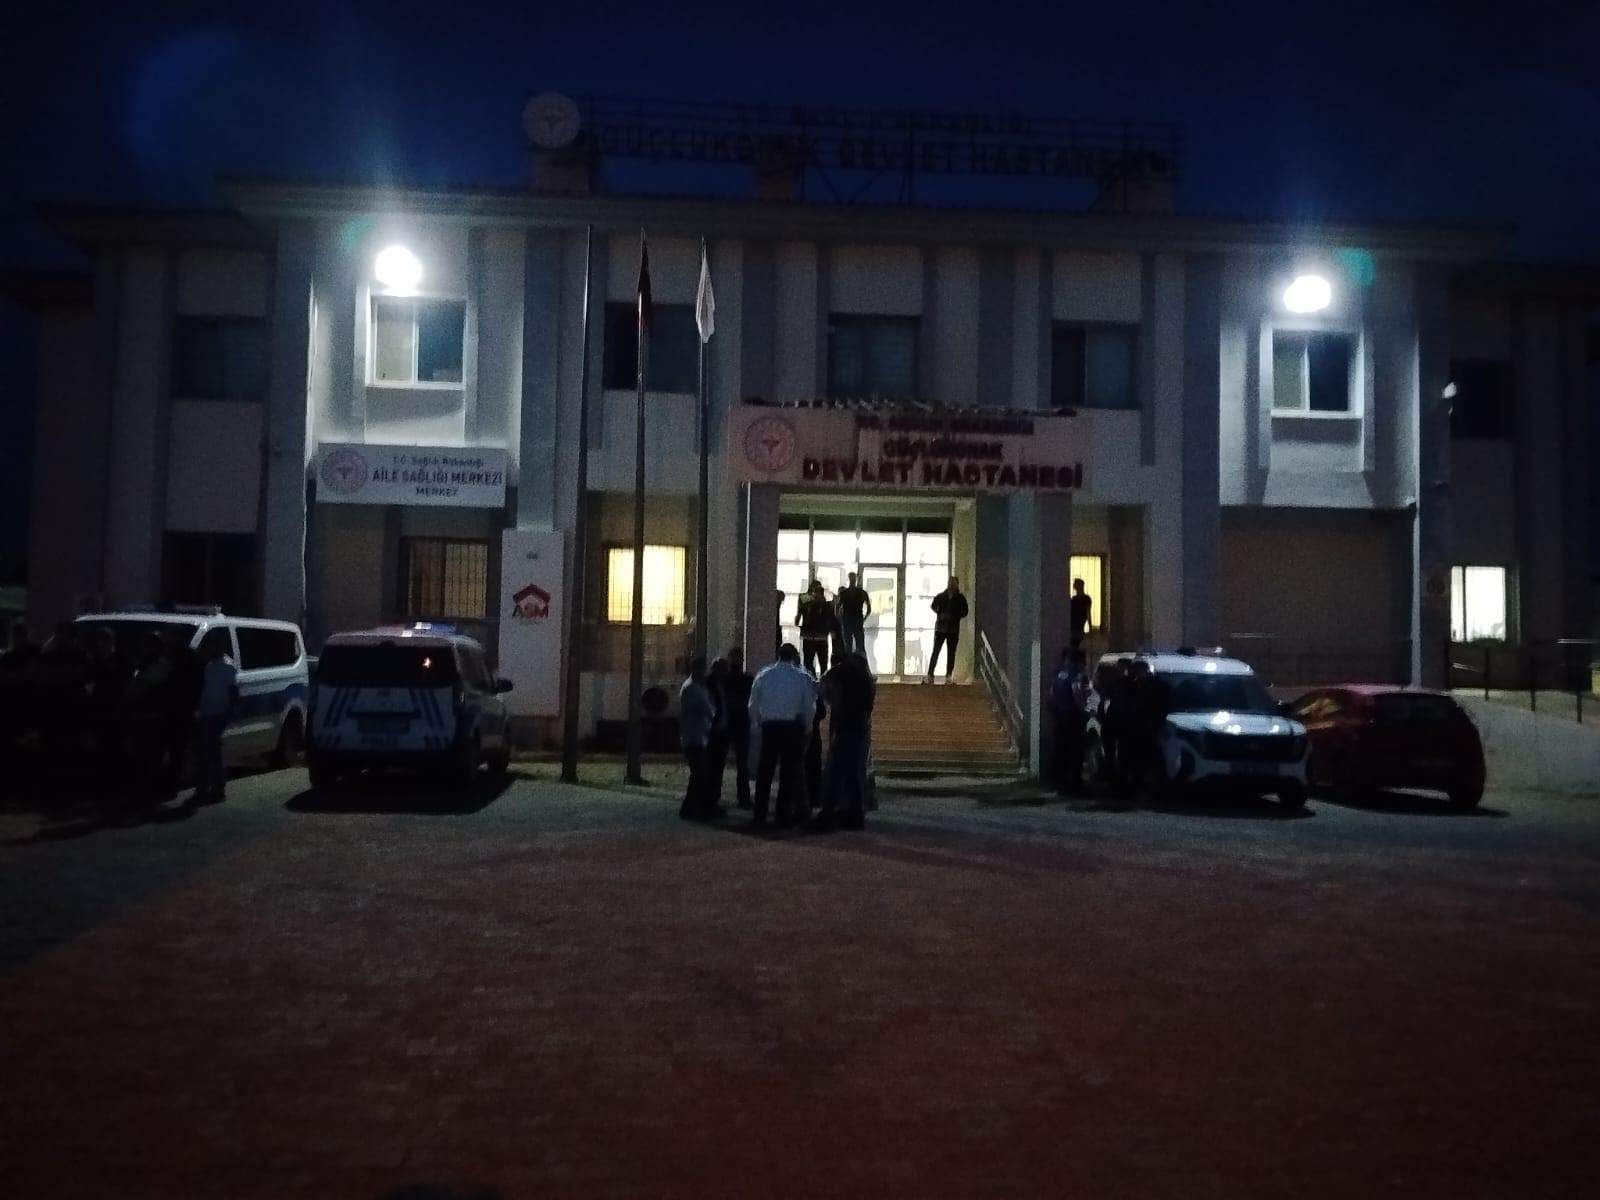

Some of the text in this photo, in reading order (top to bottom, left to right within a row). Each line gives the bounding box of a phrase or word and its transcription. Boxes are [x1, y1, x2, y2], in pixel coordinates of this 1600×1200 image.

[372, 465, 503, 487] AİLE SAĞLIĞI MERKEZİ
[803, 457, 912, 483] DEVLET
[416, 485, 460, 498] MERKEZ
